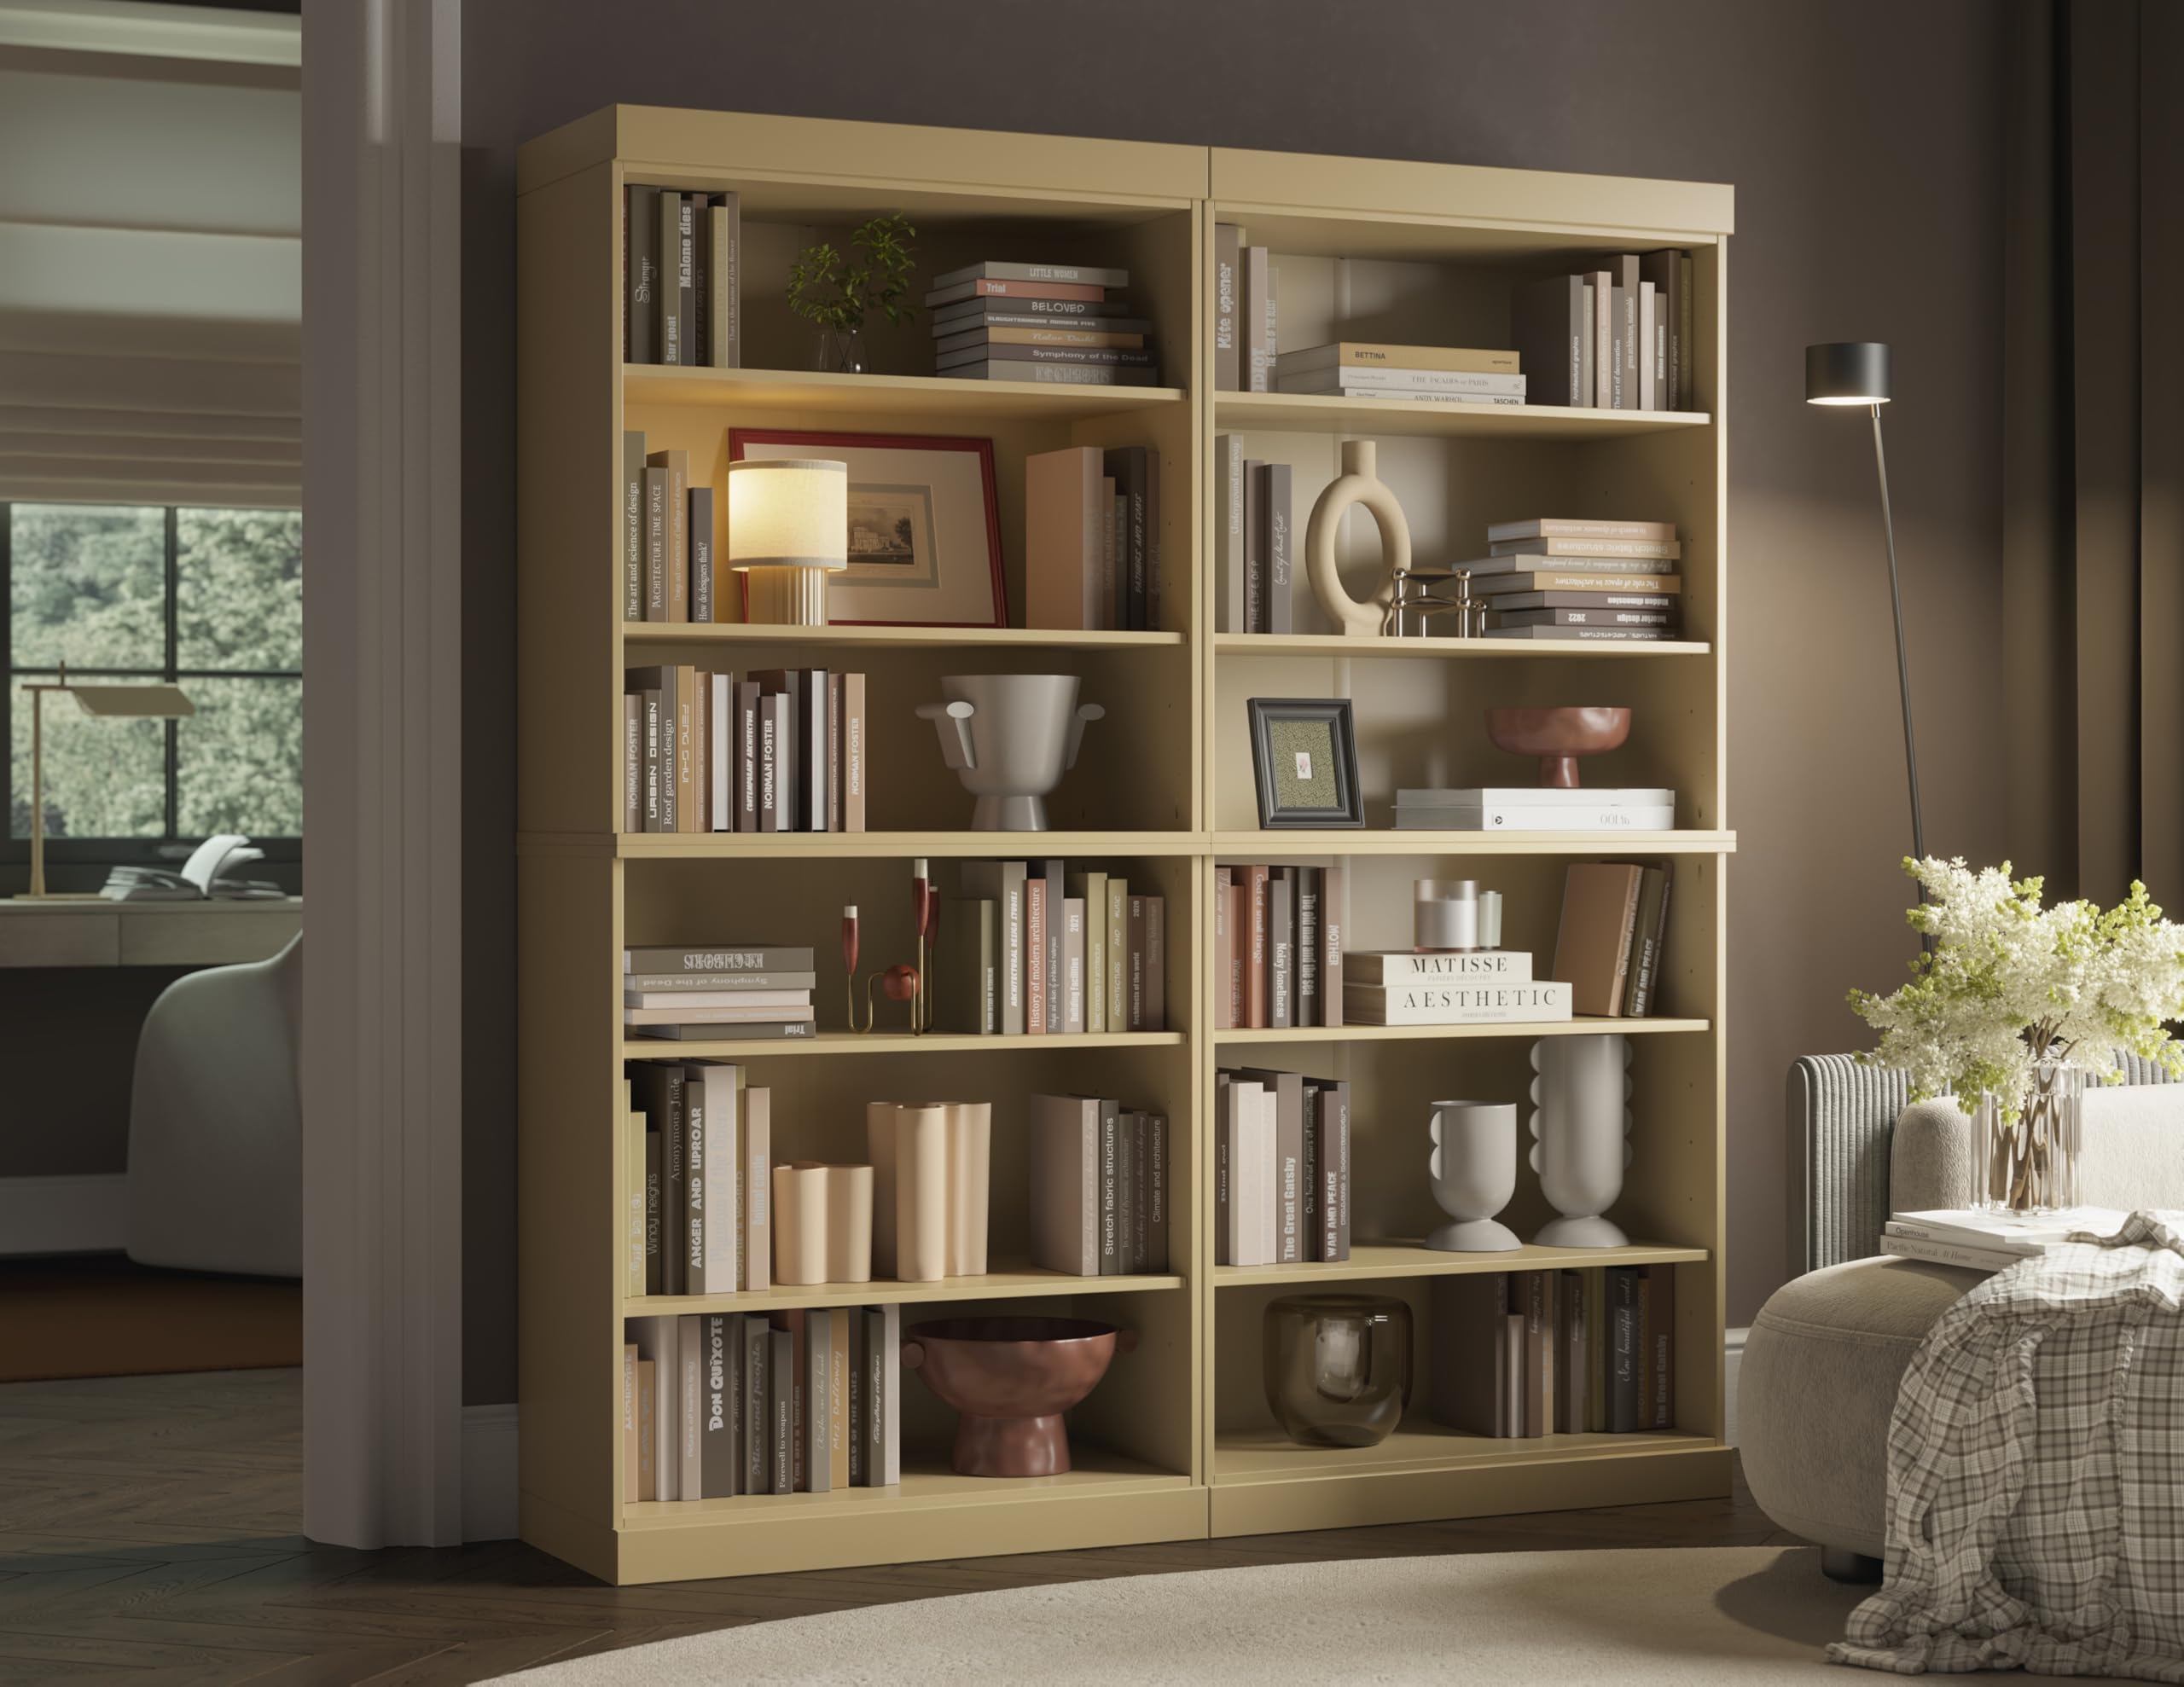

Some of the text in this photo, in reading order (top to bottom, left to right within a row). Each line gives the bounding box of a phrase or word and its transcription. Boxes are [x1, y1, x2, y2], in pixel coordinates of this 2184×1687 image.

[680, 206, 691, 288] Malone dies
[635, 256, 657, 303] Stranger
[985, 282, 1007, 293] Trial
[1031, 301, 1085, 313] BELOVED
[1217, 262, 1235, 349] Kite opener
[665, 316, 677, 362] Sur goat
[1032, 350, 1086, 360] Symphony
[1354, 351, 1385, 360] BETTINA
[627, 482, 640, 513] design
[628, 513, 637, 525] of
[628, 526, 637, 561] science
[653, 484, 661, 608] ARCHITECTURE TIME SPACE
[628, 563, 637, 582] and
[698, 542, 710, 621] How do designers think?
[628, 599, 637, 617] The
[1568, 613, 1586, 623] 2022
[628, 718, 639, 809] NORMAN FOSTER
[649, 702, 658, 819] URBAN DESIGN
[663, 718, 675, 825] Roof garden design
[764, 719, 773, 809] NORMAN FOSTER
[851, 717, 860, 795] NORMAN FOSTER
[1255, 873, 1263, 894] God
[1031, 887, 1042, 1028] History of modern architecture
[1327, 925, 1339, 965] MOTHER
[1410, 956, 1508, 974] MATISSE
[710, 977, 770, 986] Symphony
[1273, 942, 1287, 1018] Noisy loneliness
[1403, 988, 1557, 1009] AESTHETIC
[784, 1024, 806, 1035] Trial
[670, 1077, 682, 1181] Anonymous Jude
[691, 1107, 702, 1268] ANGER AND UPROAR
[1105, 1117, 1114, 1255] Stretch fabric structures
[1153, 1119, 1161, 1223] Climate and architecture
[647, 1173, 659, 1255] Windy heights
[1283, 1157, 1297, 1261] The Great Gatsby
[1305, 1197, 1314, 1215] One
[1327, 1171, 1337, 1258] WAR AND PEACE
[708, 1392, 723, 1432] DON
[779, 1400, 787, 1439] weapons
[779, 1441, 786, 1450] to
